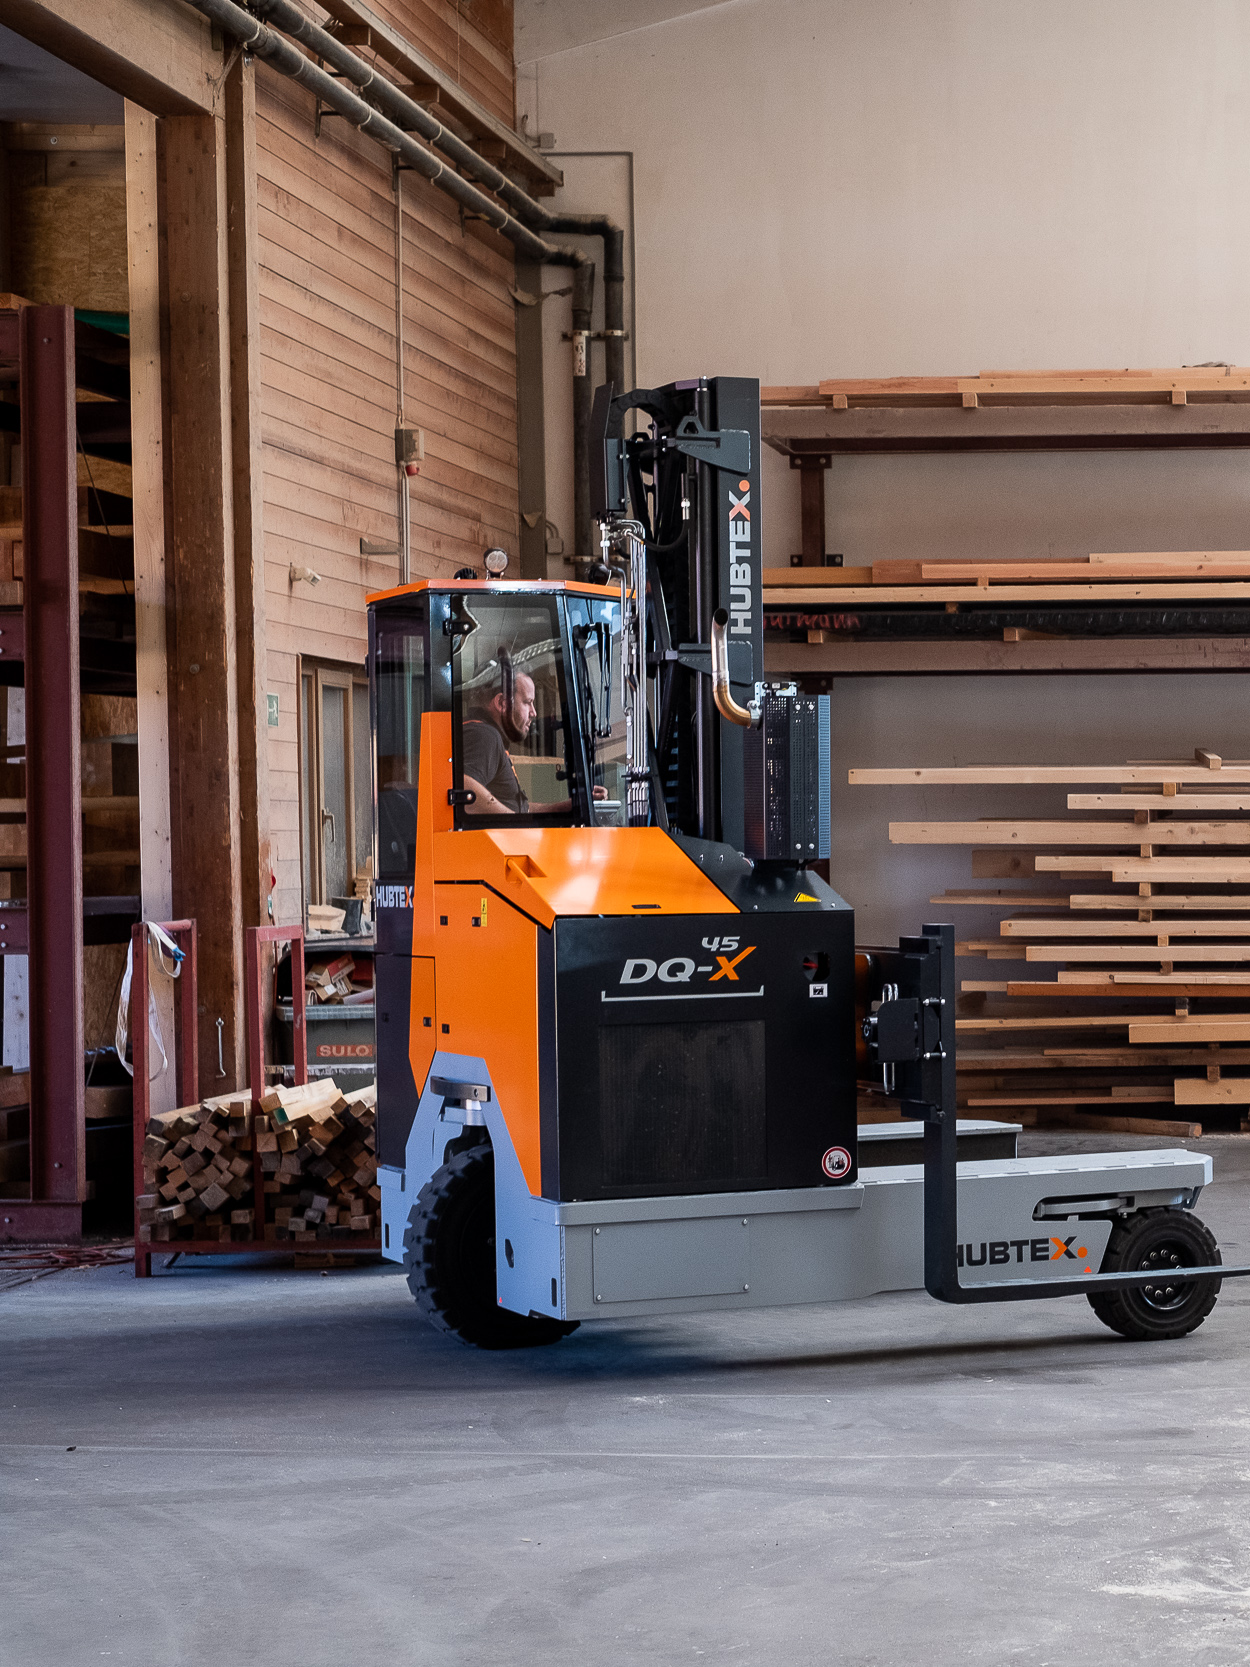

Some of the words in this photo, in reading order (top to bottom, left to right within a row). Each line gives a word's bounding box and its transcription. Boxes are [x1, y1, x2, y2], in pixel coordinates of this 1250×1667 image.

[376, 885, 413, 908] HUBTEX
[701, 936, 741, 952] 45
[619, 946, 757, 984] DQ-X
[319, 1044, 369, 1057] SULO
